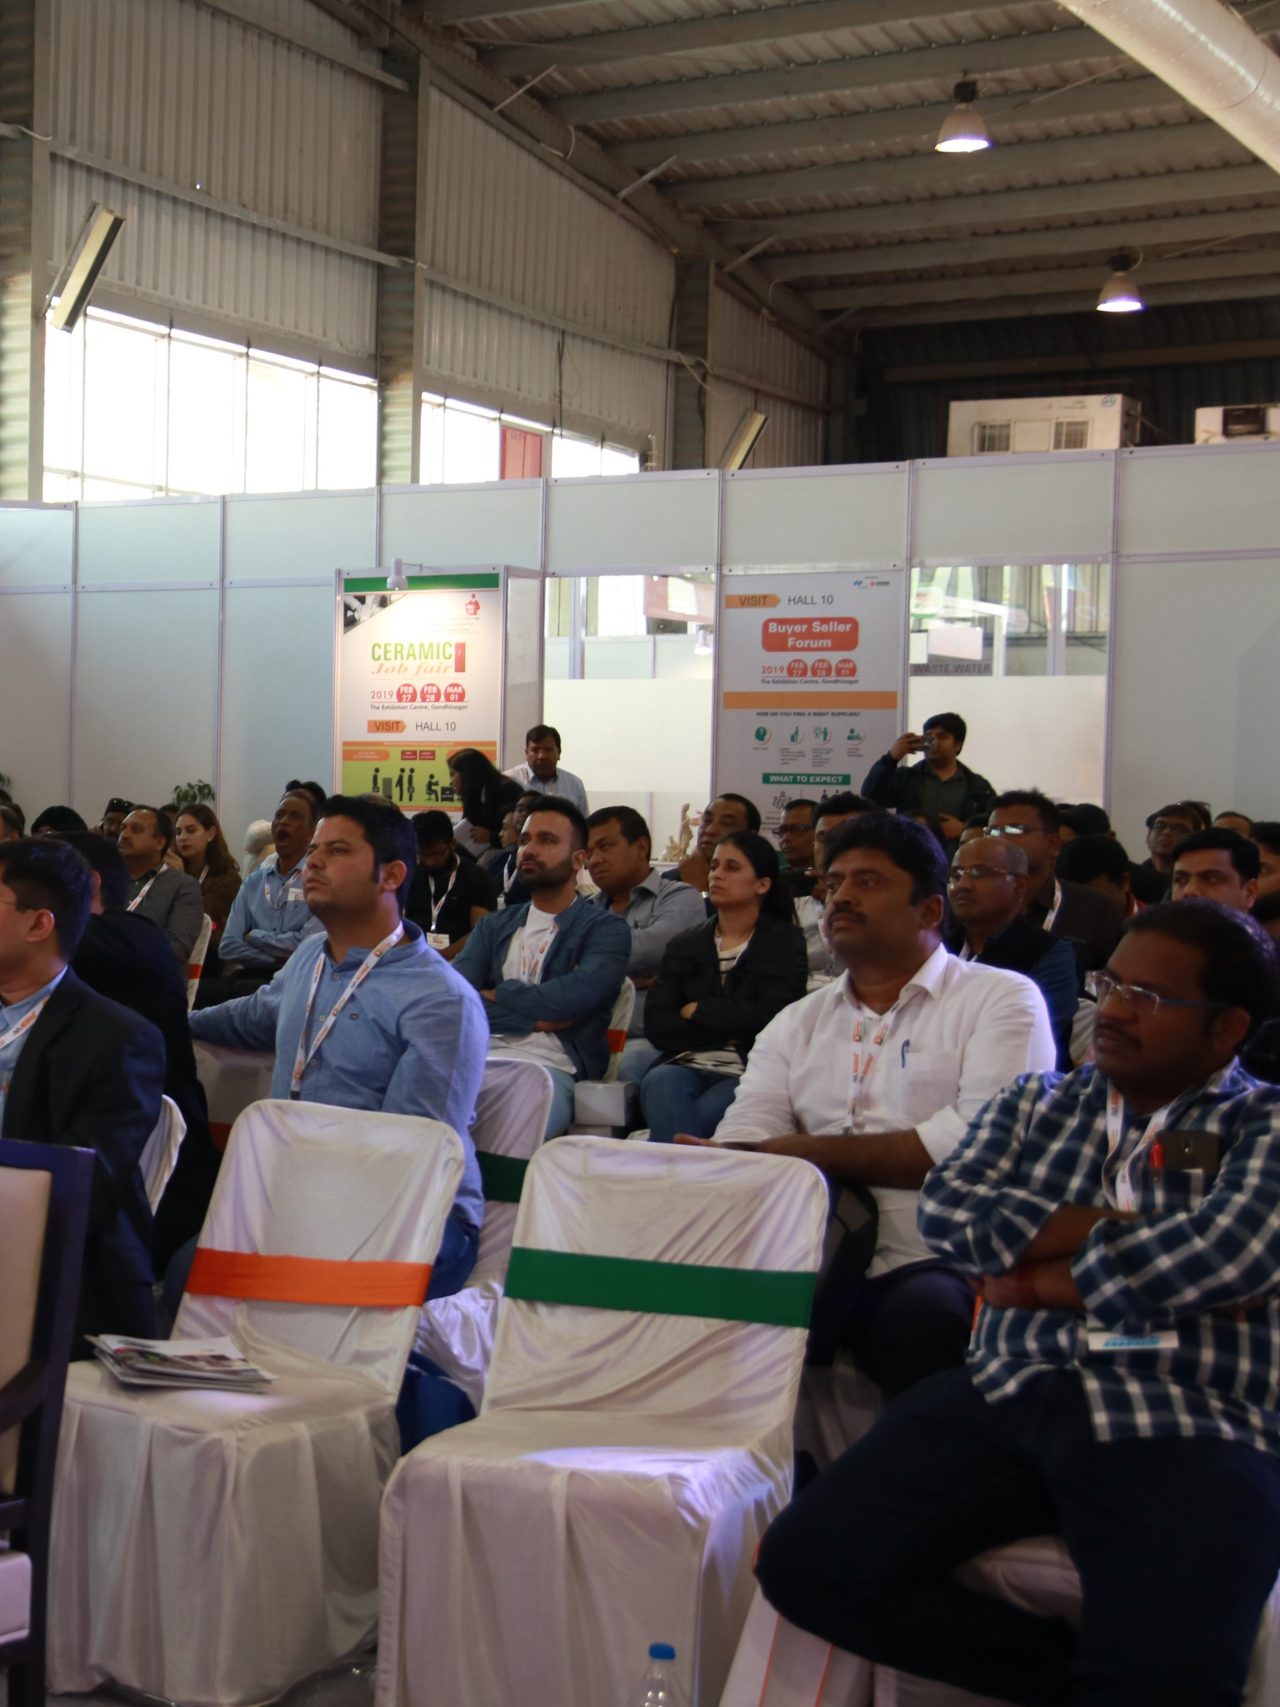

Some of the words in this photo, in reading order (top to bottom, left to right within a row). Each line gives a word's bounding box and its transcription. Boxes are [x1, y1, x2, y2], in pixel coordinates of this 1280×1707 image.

[739, 596, 768, 606] VISIT
[788, 596, 816, 605] HALL
[821, 595, 834, 605] 10
[768, 623, 808, 634] Buyer
[812, 622, 852, 632] Seller
[788, 638, 832, 648] Forum
[372, 642, 453, 661] CERAMIC
[372, 663, 408, 675] Job
[412, 663, 452, 677] fair
[761, 666, 785, 674] 2019
[371, 690, 394, 699] 2019
[375, 722, 401, 731] VISIT
[416, 722, 441, 731] HALL
[445, 722, 456, 731] 10
[797, 775, 807, 783] TO
